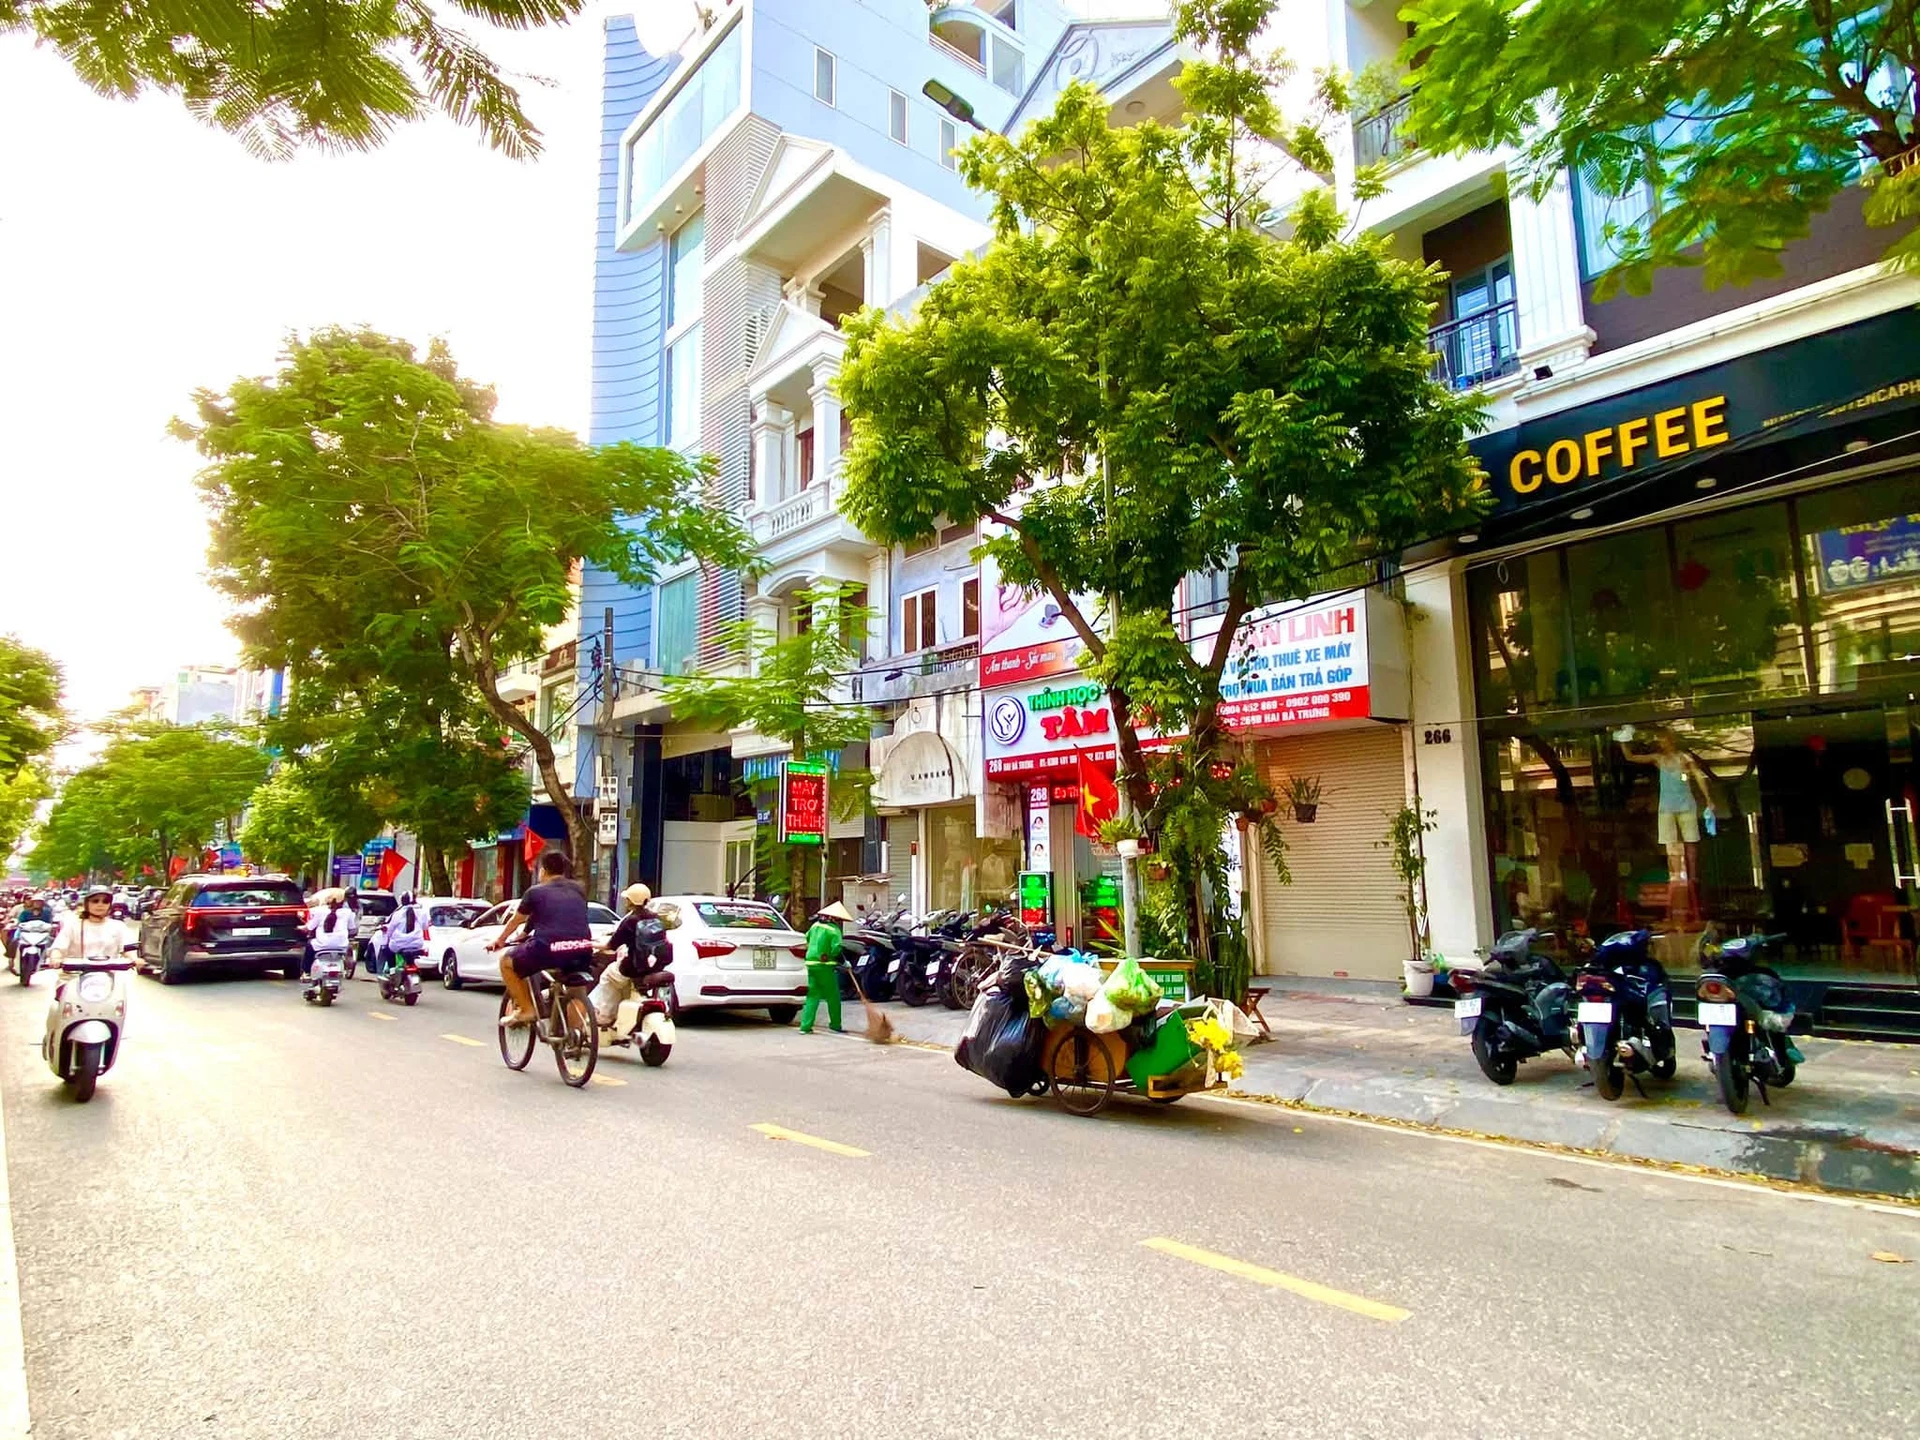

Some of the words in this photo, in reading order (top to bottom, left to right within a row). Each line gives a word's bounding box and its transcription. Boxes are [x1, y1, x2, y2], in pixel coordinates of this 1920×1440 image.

[1510, 395, 1729, 493] COFFEE
[1288, 608, 1355, 643] LINH
[1273, 648, 1301, 669] THUÊ
[1305, 648, 1321, 664] XE
[1324, 641, 1352, 661] MÁY
[1220, 683, 1240, 699] TRỢ
[1272, 672, 1296, 694] BÁN
[1299, 668, 1322, 688] TRẢ
[1327, 665, 1353, 684] GÓP
[1067, 684, 1101, 708] HỌC
[1331, 691, 1351, 704] 390
[1040, 706, 1110, 741] TÂM
[1264, 711, 1280, 723] HAI
[1282, 708, 1295, 721] BÀ
[1424, 728, 1452, 744] 266
[791, 780, 818, 796] MÁY
[1031, 787, 1047, 801] 268
[791, 797, 818, 813] TRỢ
